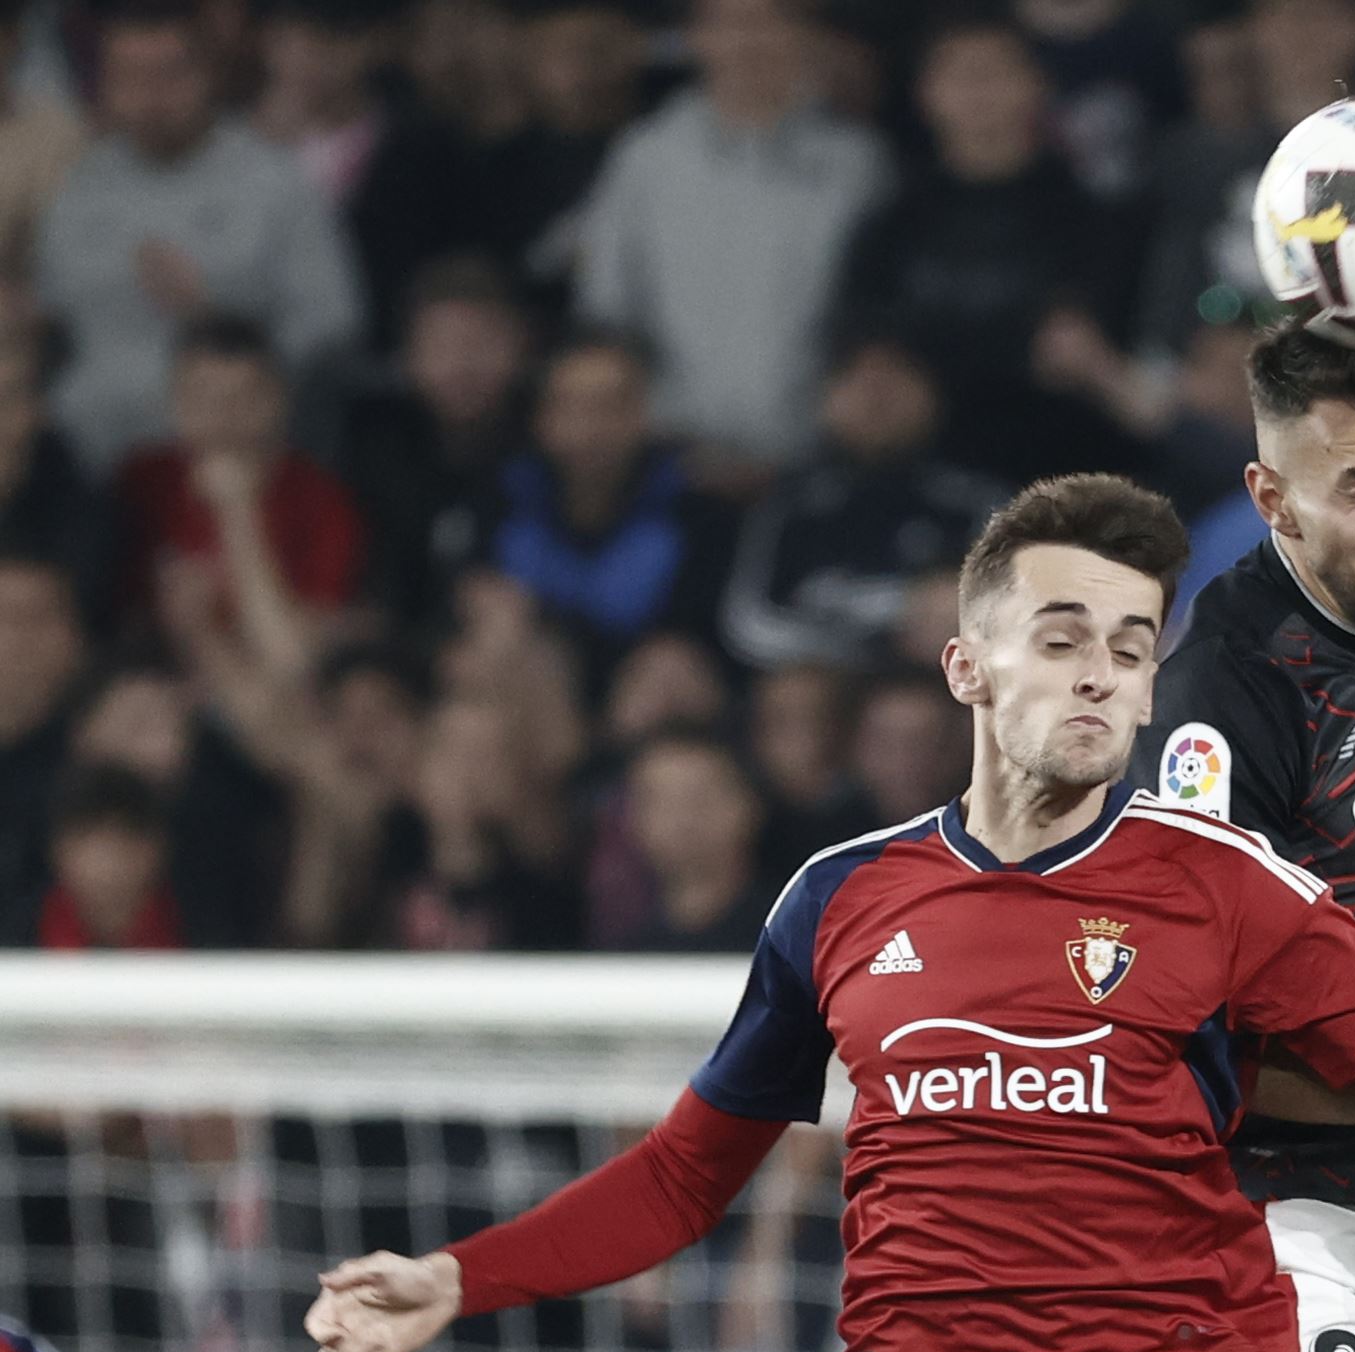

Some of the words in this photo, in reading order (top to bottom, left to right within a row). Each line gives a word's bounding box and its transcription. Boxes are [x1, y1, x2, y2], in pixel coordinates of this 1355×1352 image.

[1071, 946, 1083, 958] C
[869, 958, 923, 975] adidas
[1090, 986, 1103, 998] O
[884, 1051, 1110, 1116] verleal
